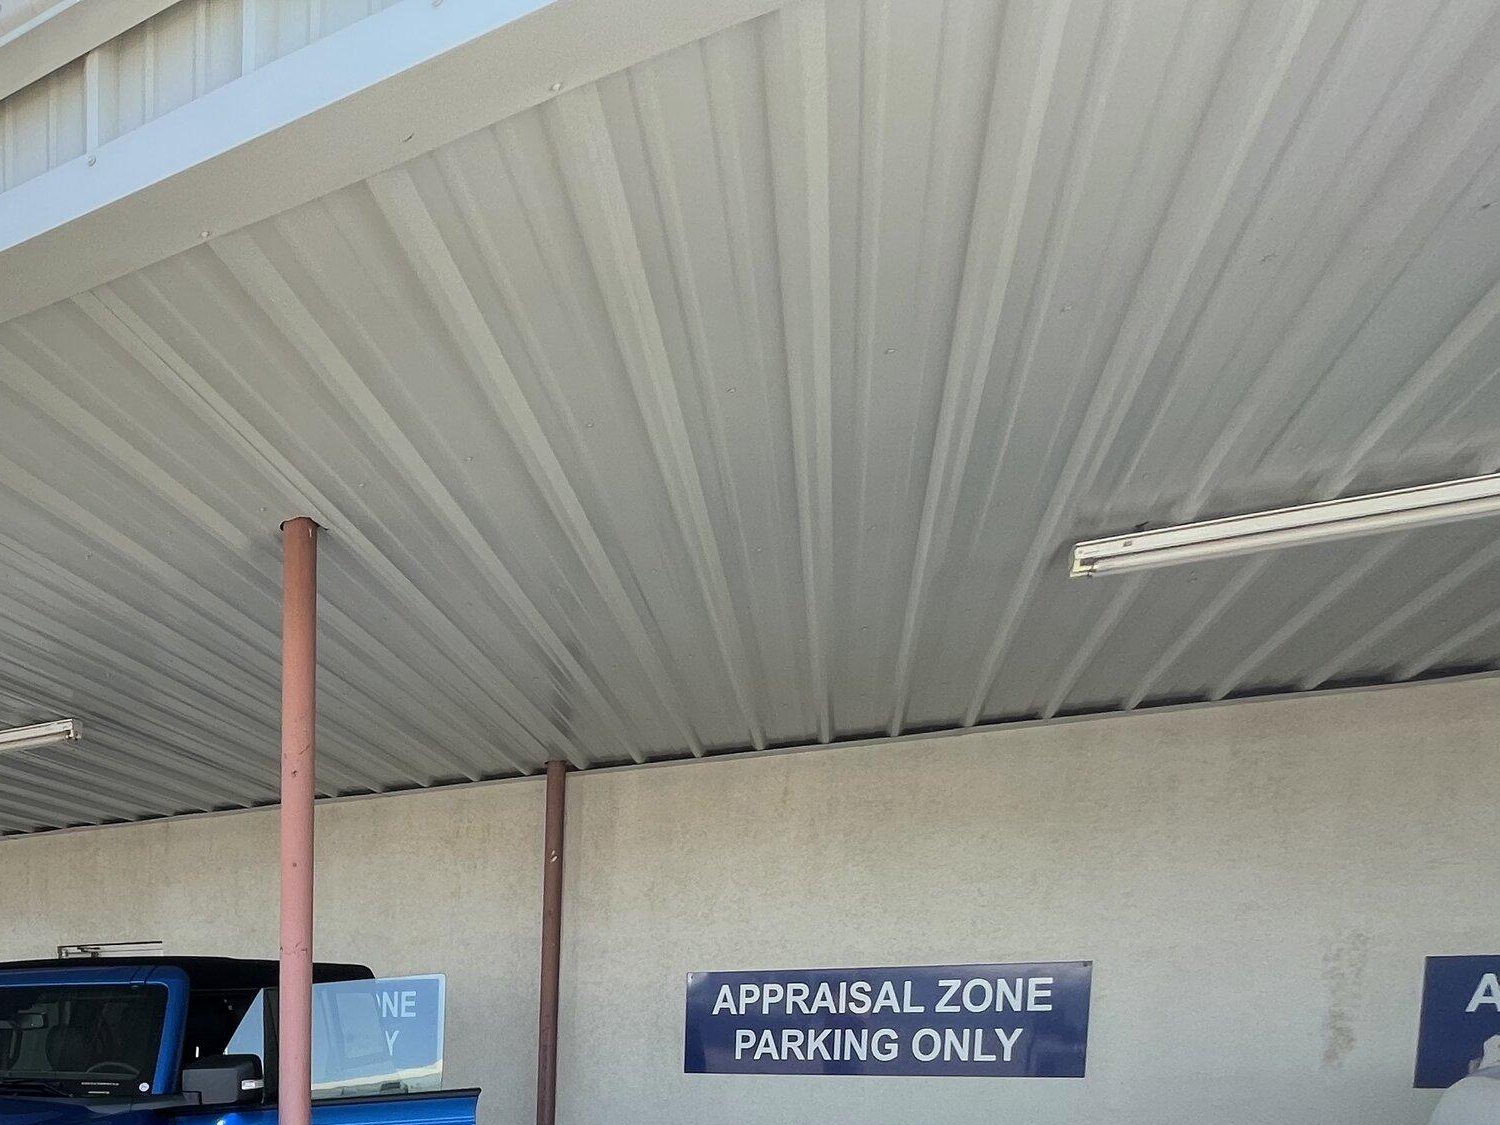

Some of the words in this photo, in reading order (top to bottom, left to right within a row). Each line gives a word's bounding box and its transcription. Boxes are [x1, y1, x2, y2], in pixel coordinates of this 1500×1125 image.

[711, 980, 926, 1015] APPRAISAL
[934, 977, 1054, 1013] ZONE
[734, 1028, 899, 1062] PARKING
[911, 1028, 1024, 1062] ONLY
